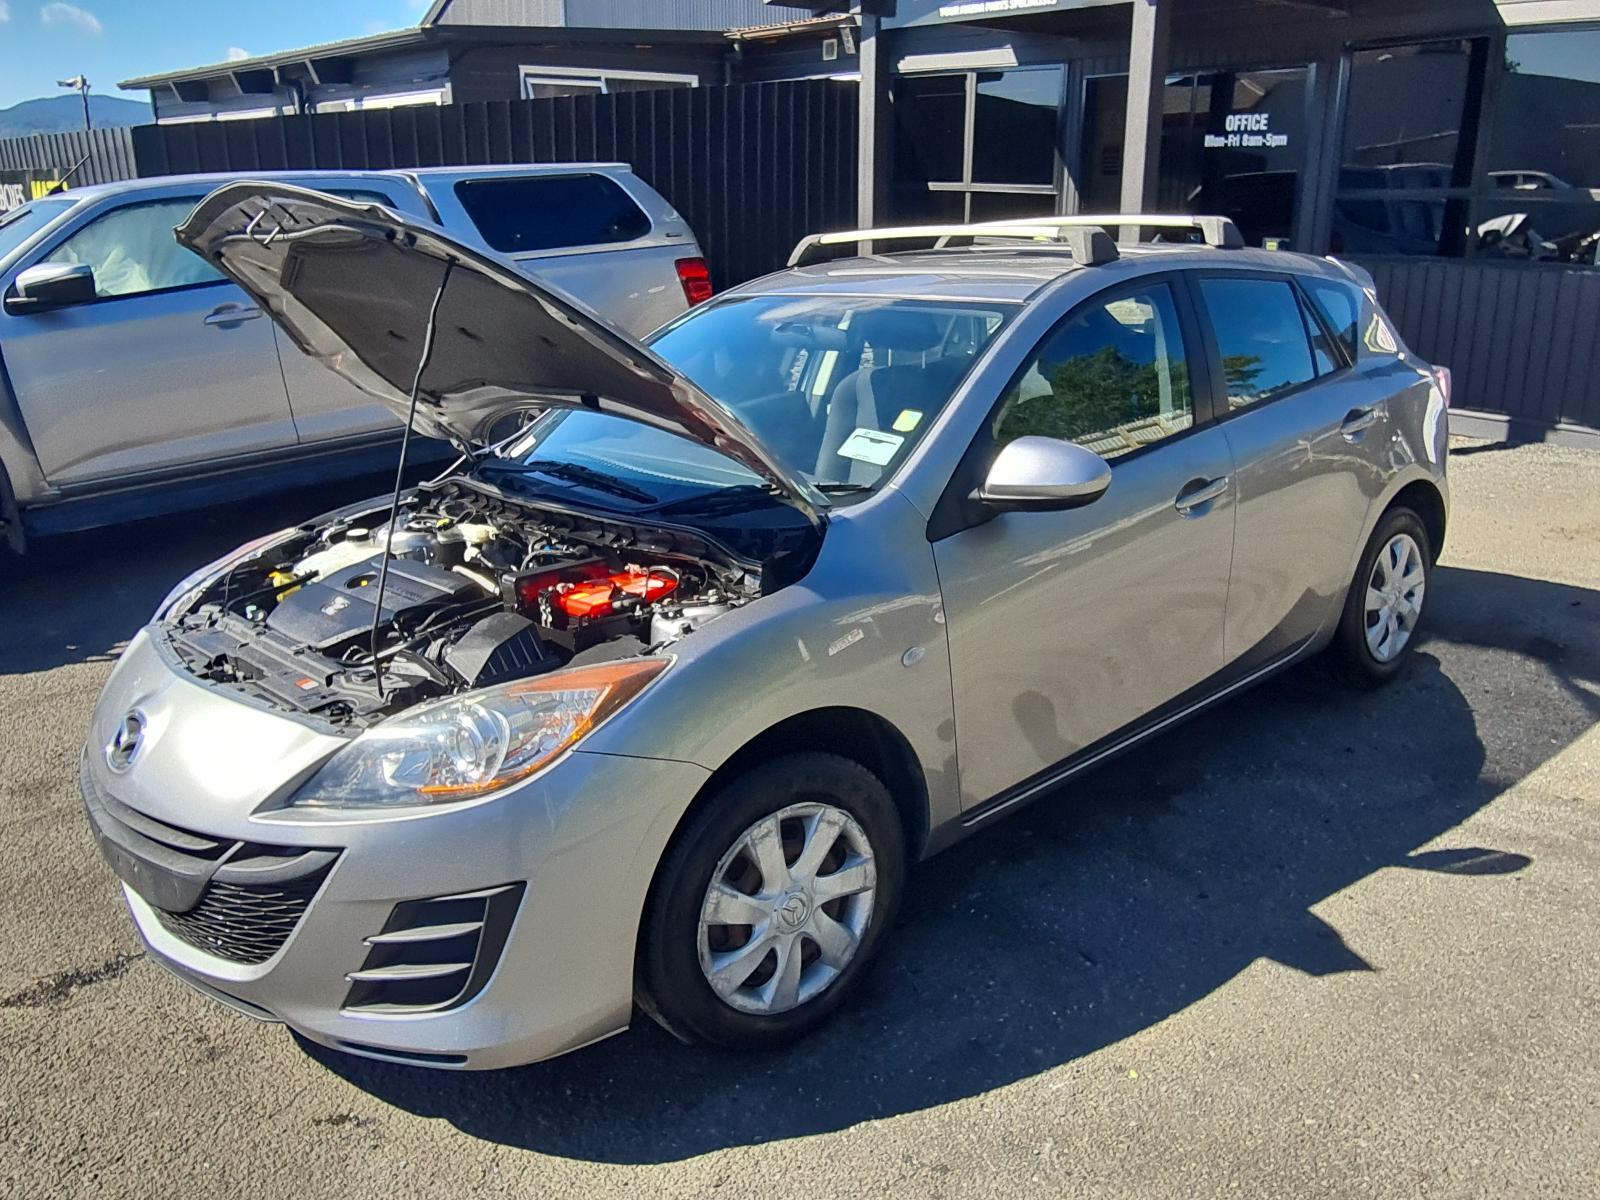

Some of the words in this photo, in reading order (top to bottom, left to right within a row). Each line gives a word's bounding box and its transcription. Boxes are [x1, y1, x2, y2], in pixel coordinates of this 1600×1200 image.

[1225, 113, 1269, 131] OFFICE
[1204, 134, 1240, 147] Mon-Fri
[1241, 133, 1288, 147] 8am-5pm
